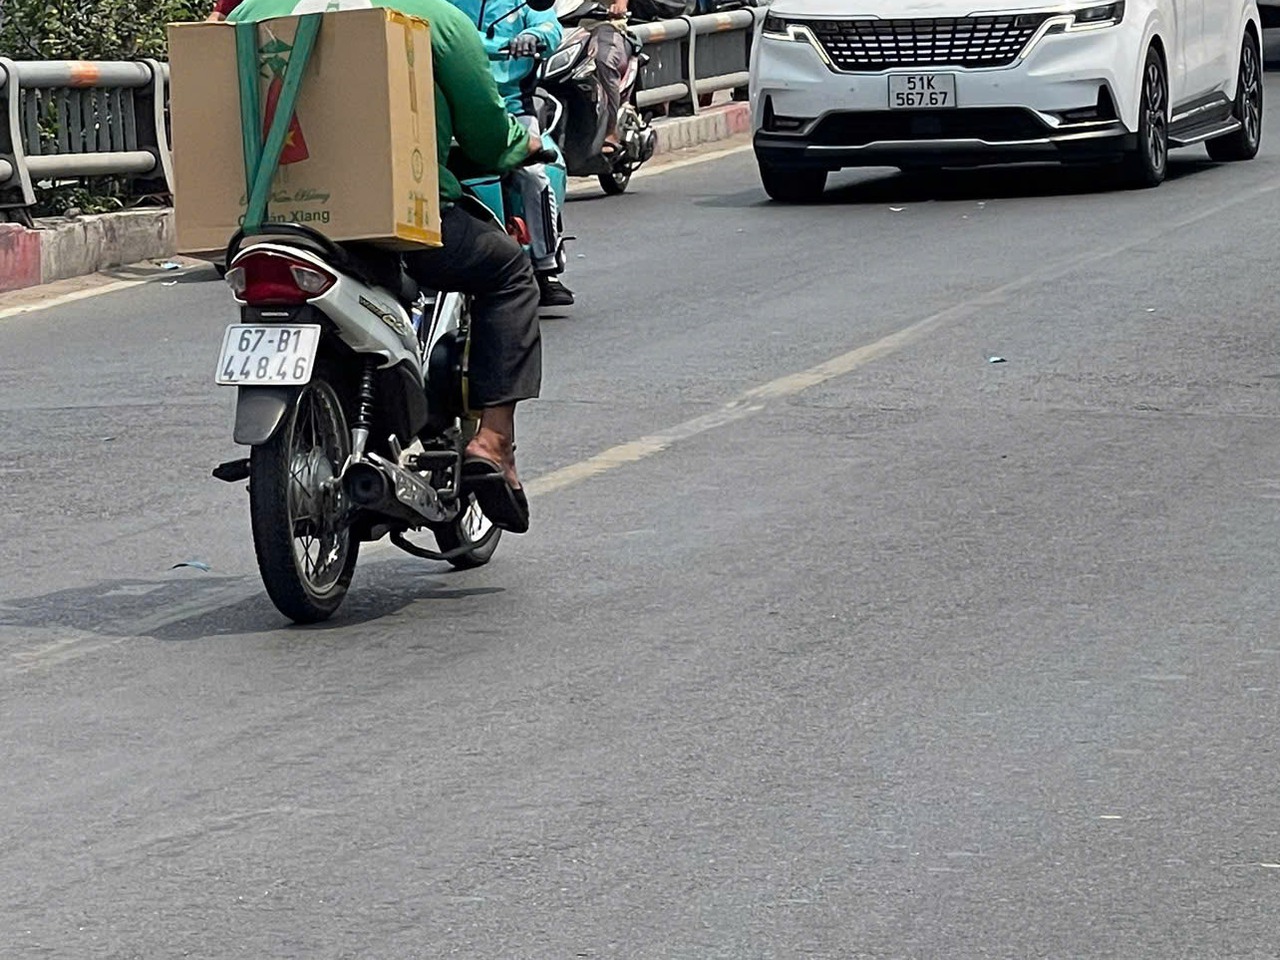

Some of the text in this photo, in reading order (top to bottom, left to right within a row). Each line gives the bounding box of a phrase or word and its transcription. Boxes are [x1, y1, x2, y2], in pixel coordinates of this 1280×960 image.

[907, 75, 935, 90] 51K
[896, 91, 948, 106] 567.67
[238, 329, 302, 353] 67-B1
[223, 356, 307, 380] 448.46
